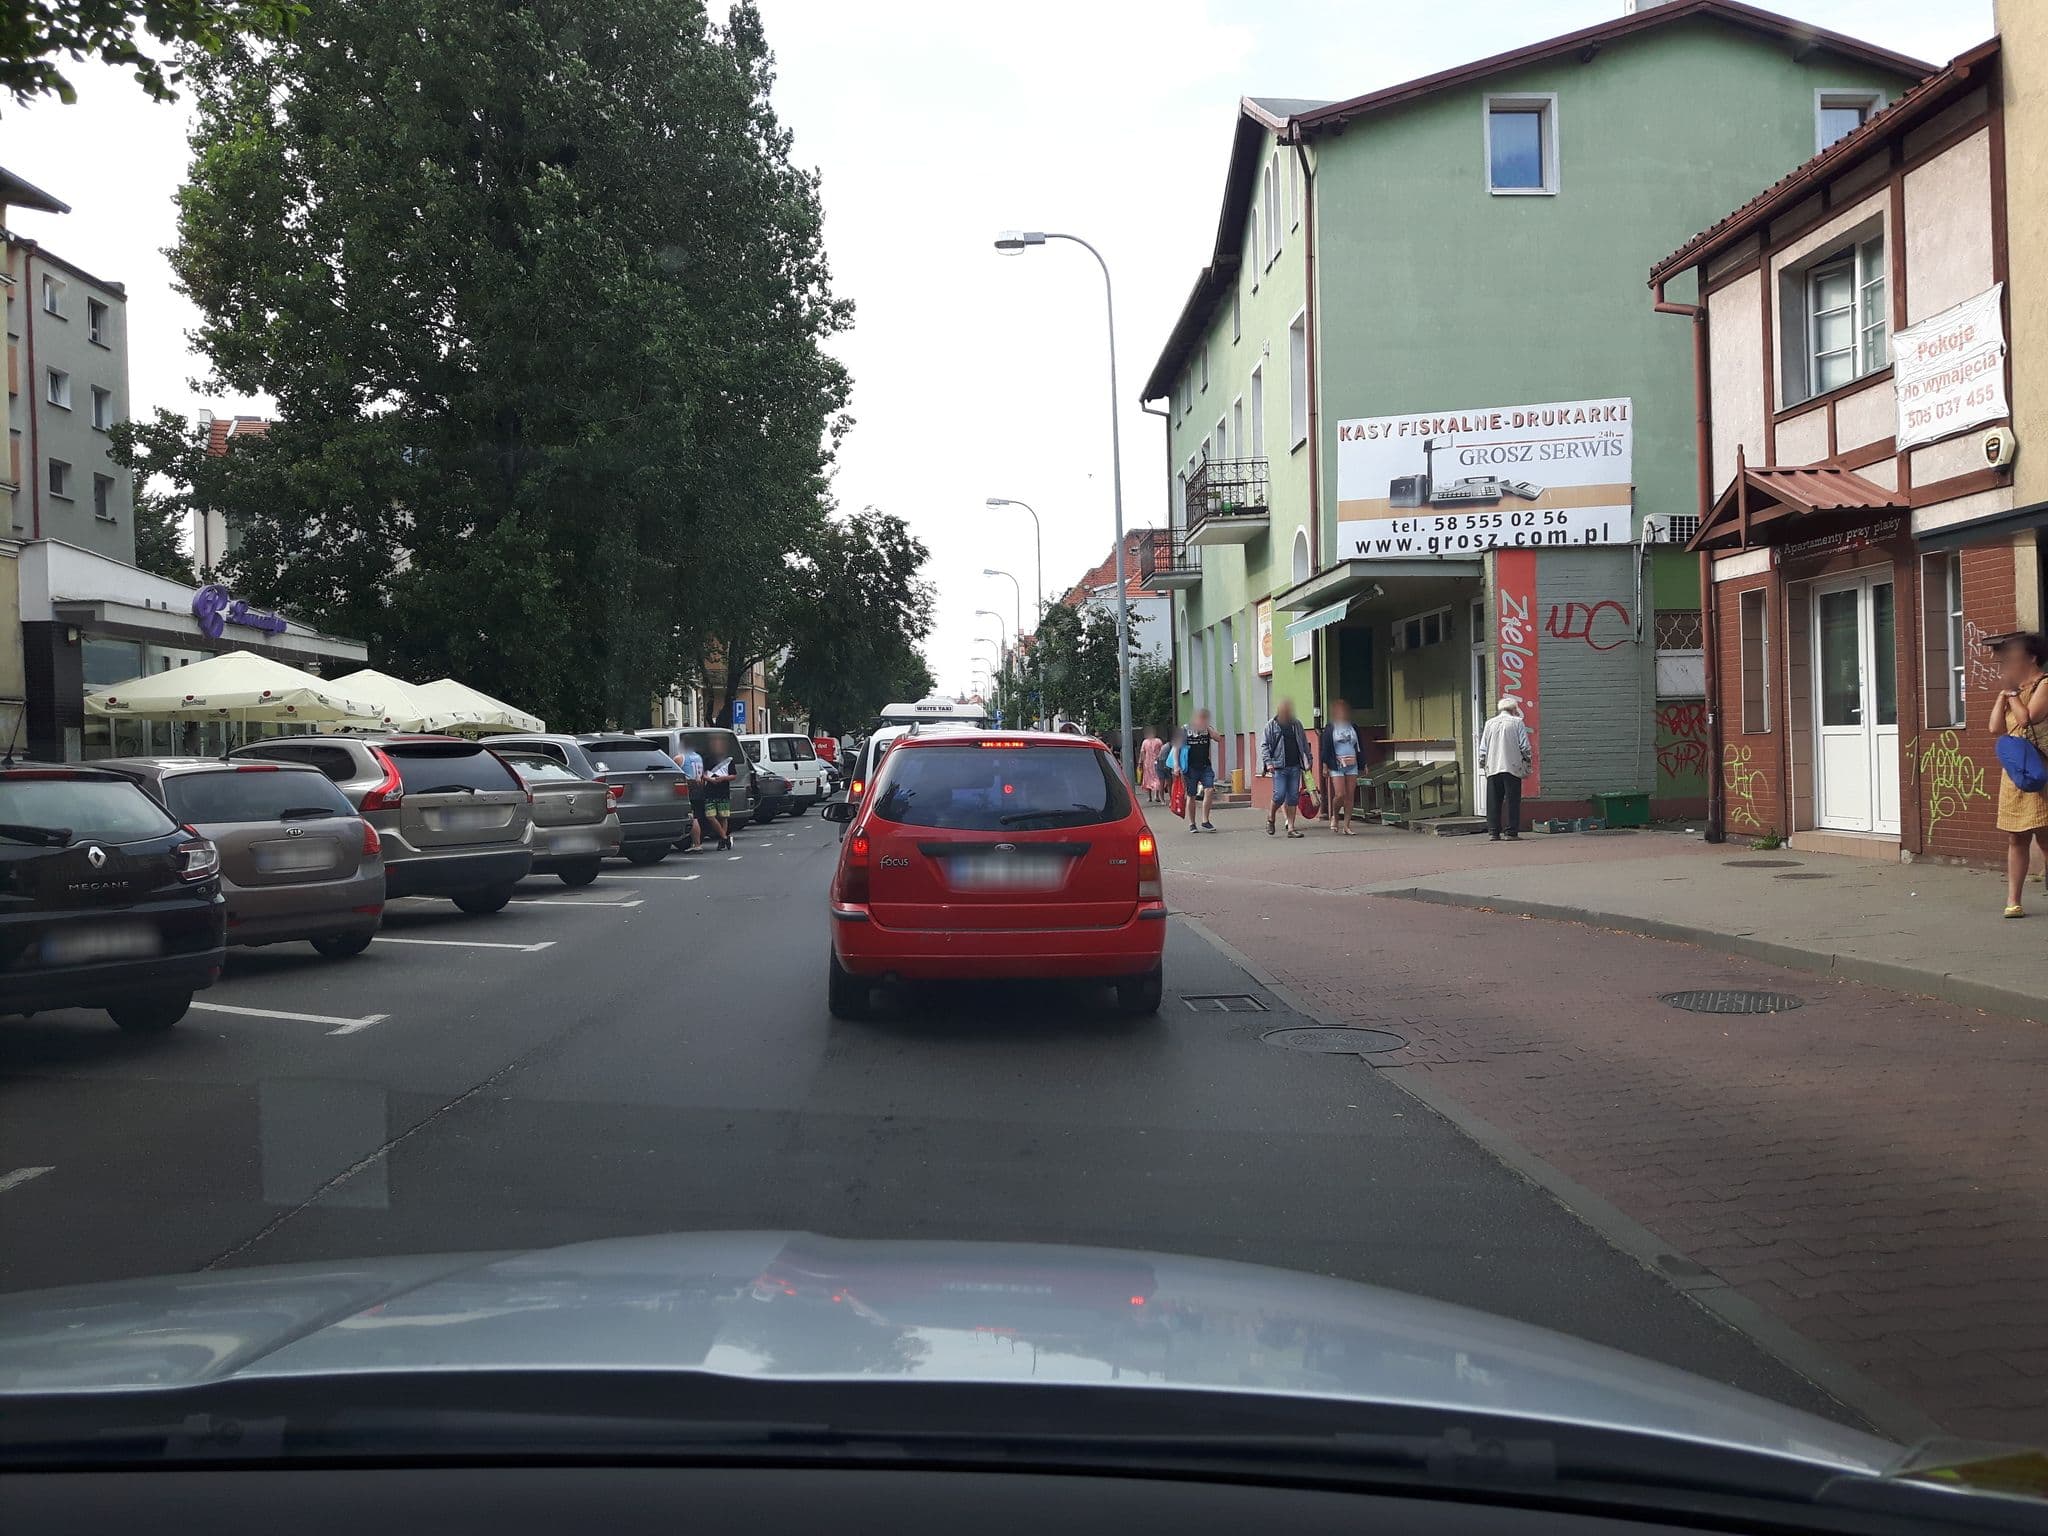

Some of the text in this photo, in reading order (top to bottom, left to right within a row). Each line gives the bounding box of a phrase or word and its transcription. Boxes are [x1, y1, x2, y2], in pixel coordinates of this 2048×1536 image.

[1917, 325, 1976, 361] Pokoje
[1906, 383, 1995, 429] 505 037 455
[1339, 404, 1629, 442] KASY FISKALNE-DRUKARKI
[1458, 438, 1624, 467] GROSZ SERWIS
[1391, 510, 1569, 534] tel. 58 555 02 56
[1355, 522, 1610, 554] www.grosz.com.pl
[1783, 531, 1844, 556] Apartamenty
[1846, 525, 1871, 543] przy
[735, 702, 744, 718] P
[68, 881, 129, 891] MEGANE
